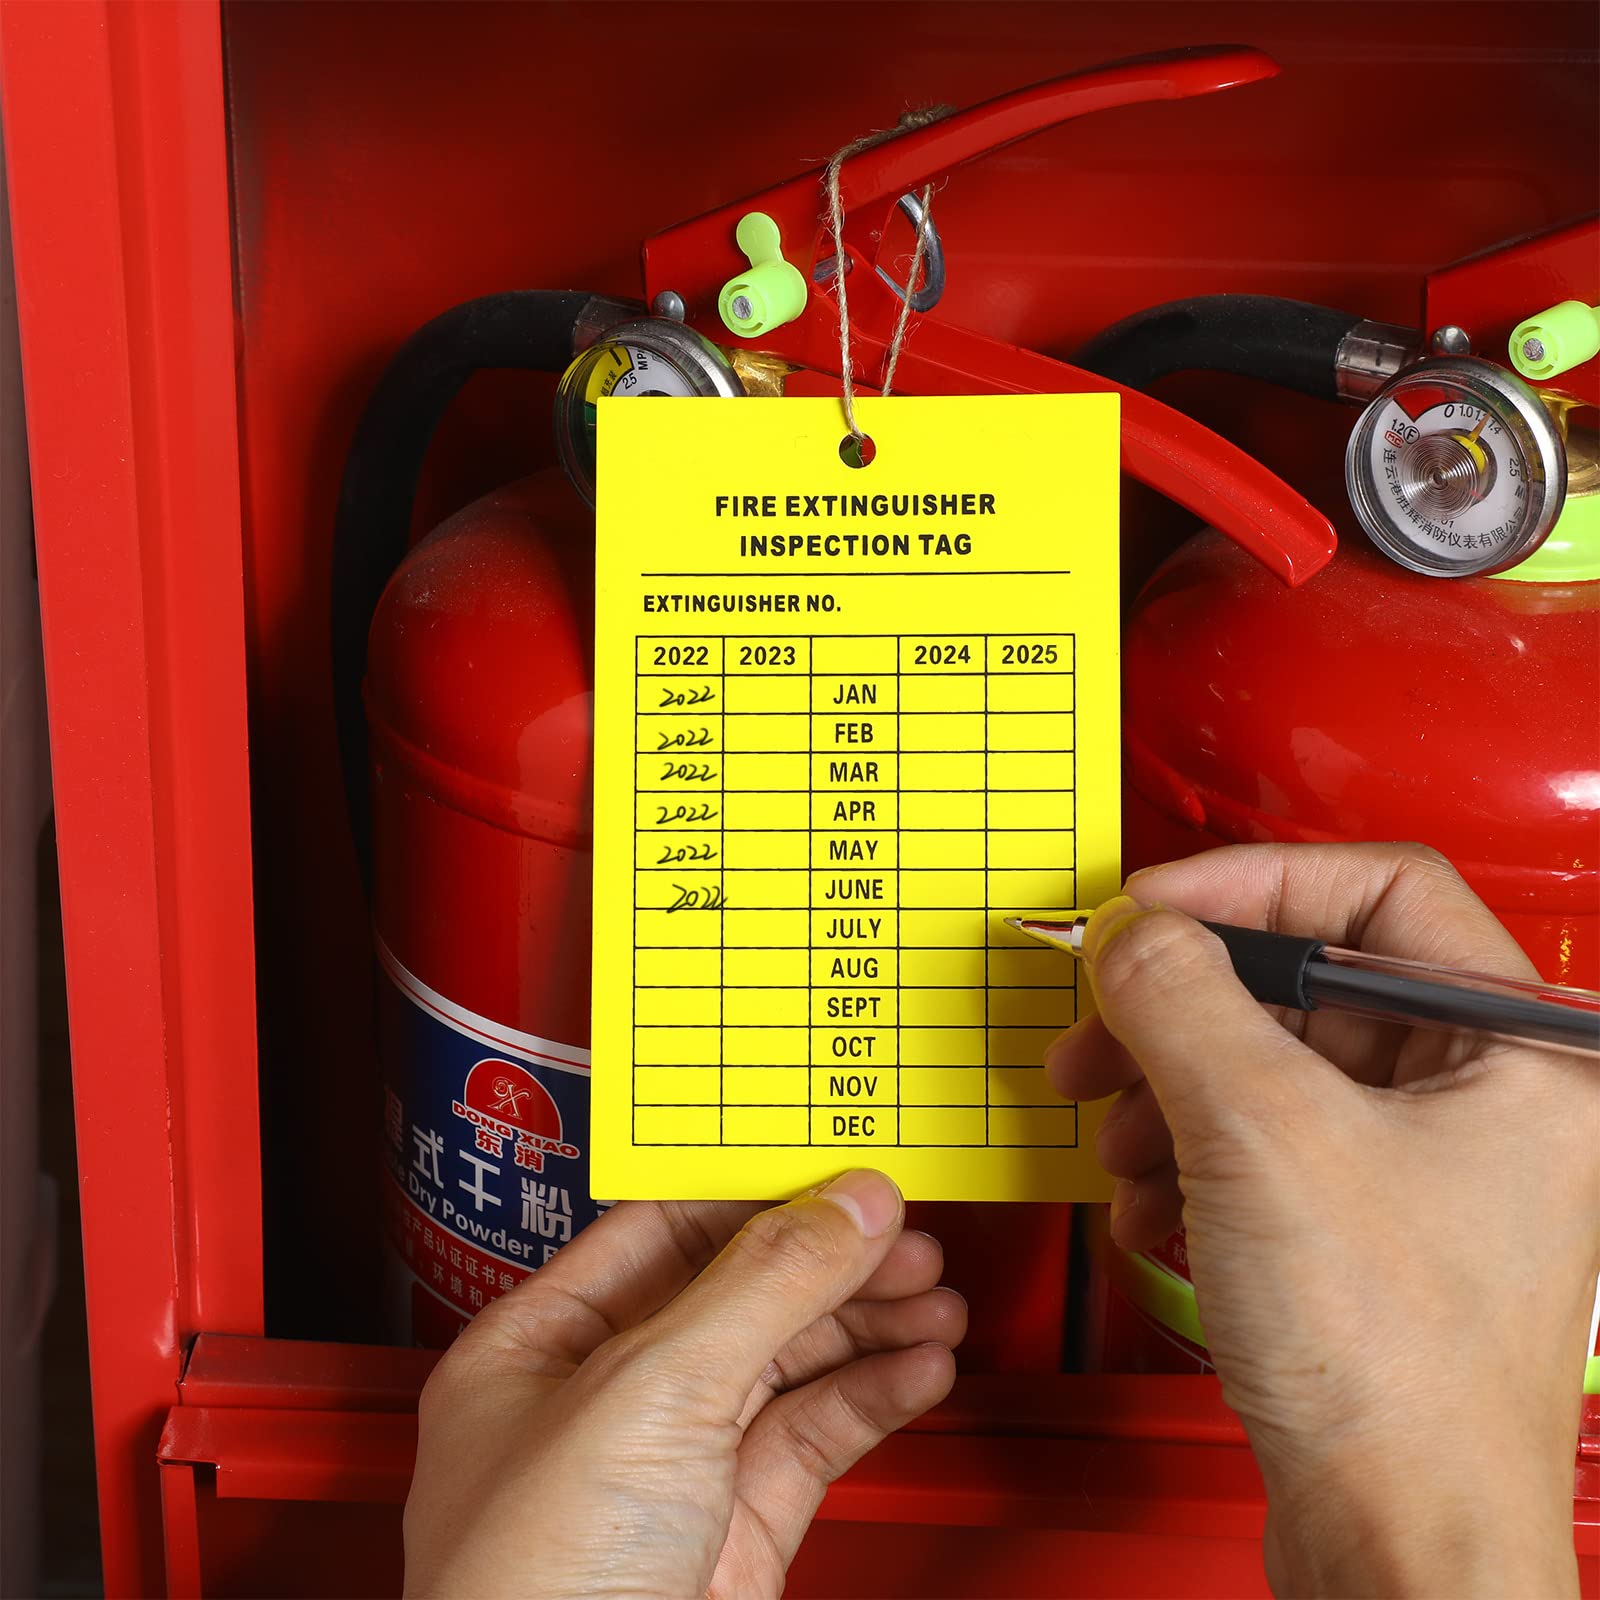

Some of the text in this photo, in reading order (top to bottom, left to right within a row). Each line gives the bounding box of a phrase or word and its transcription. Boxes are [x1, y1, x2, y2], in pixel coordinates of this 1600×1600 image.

[1443, 404, 1455, 418] 0
[1459, 405, 1474, 419] 1.0
[715, 493, 996, 517] FIRE EXTINGUISHER
[740, 533, 972, 557] INSPECTION TAG
[643, 594, 841, 613] EXTINGUISHER NO.
[653, 644, 1058, 666] 2022 2023 2024 2025
[659, 685, 716, 708] 2022
[833, 683, 877, 705] JAN
[657, 727, 714, 751] 2022
[835, 722, 874, 744] FEB
[660, 761, 718, 782] 2022
[830, 761, 879, 783] MAR
[656, 803, 718, 825] 2022
[833, 800, 876, 822] APR
[656, 843, 718, 865] 2022
[829, 839, 879, 861] MAY
[666, 883, 728, 914] 2022
[825, 878, 884, 900] JUNE
[826, 918, 882, 939] JULY
[830, 957, 878, 979] AUG
[827, 996, 881, 1018] SEPT
[832, 1036, 876, 1058] OCT
[829, 1075, 878, 1097] NOV
[452, 1100, 580, 1159] DONG XIAO
[832, 1115, 875, 1137] DEC
[475, 1127, 545, 1173] 东消
[408, 1171, 437, 1216] Dry
[442, 1198, 534, 1260] Powder
[432, 1261, 490, 1309] 环境和
